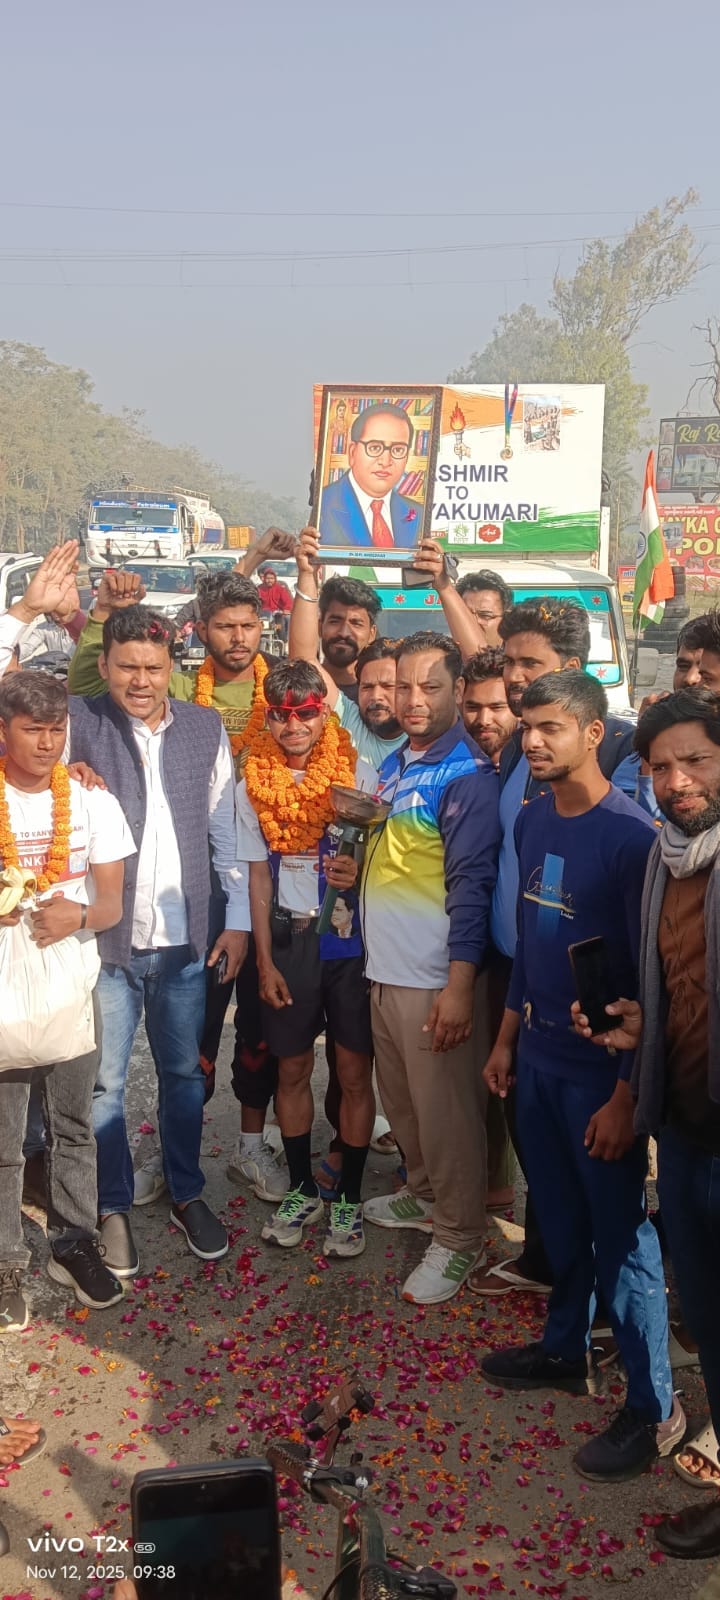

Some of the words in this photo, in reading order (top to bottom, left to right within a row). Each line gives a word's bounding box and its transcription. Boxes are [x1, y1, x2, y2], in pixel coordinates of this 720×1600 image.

[677, 424, 702, 443] Raj
[445, 486, 469, 500] TO
[20, 831, 30, 839] TO
